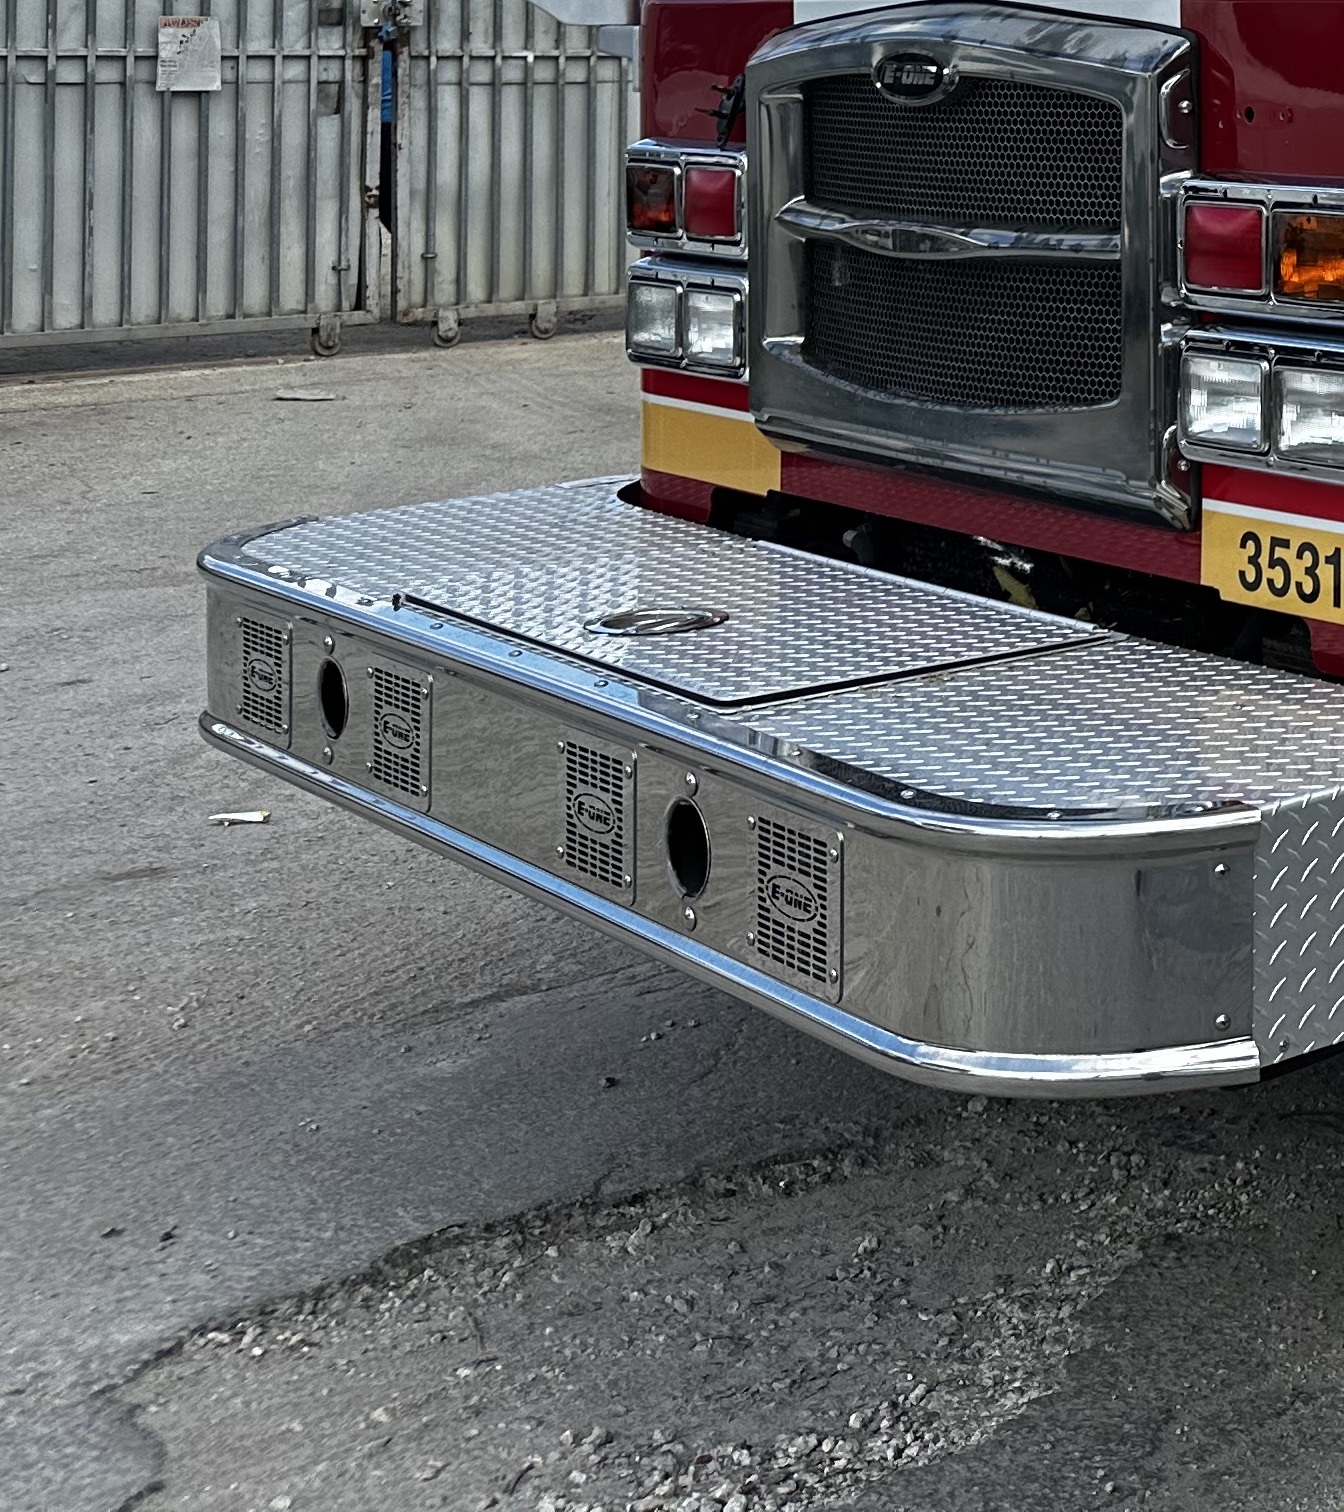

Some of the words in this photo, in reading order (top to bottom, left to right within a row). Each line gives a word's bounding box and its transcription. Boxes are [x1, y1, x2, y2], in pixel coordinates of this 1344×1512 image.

[883, 64, 938, 85] E-ONE
[577, 801, 611, 828] E-ONE
[771, 883, 813, 915] E-ONE
